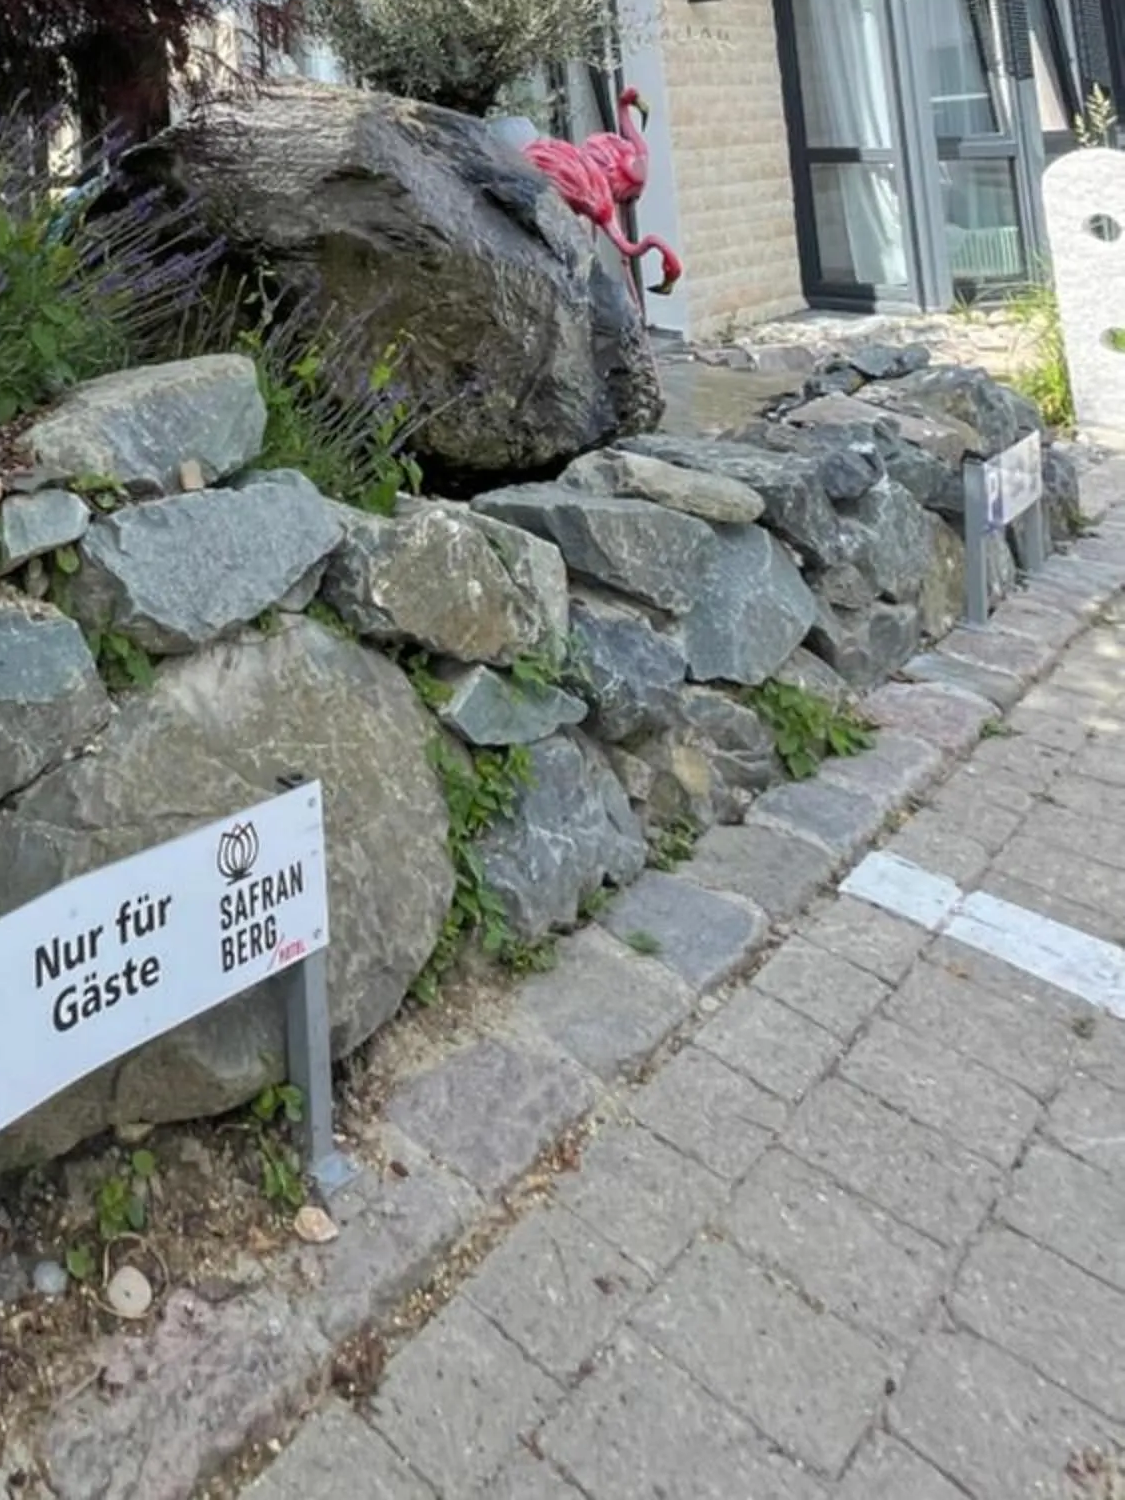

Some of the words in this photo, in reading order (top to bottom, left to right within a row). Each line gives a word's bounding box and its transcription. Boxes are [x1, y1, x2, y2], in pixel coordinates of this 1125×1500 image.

[220, 861, 303, 930] SAFRAN
[34, 925, 104, 989] Nur
[115, 894, 172, 945] für
[221, 914, 277, 973] BERG
[53, 955, 161, 1032] Gäste
